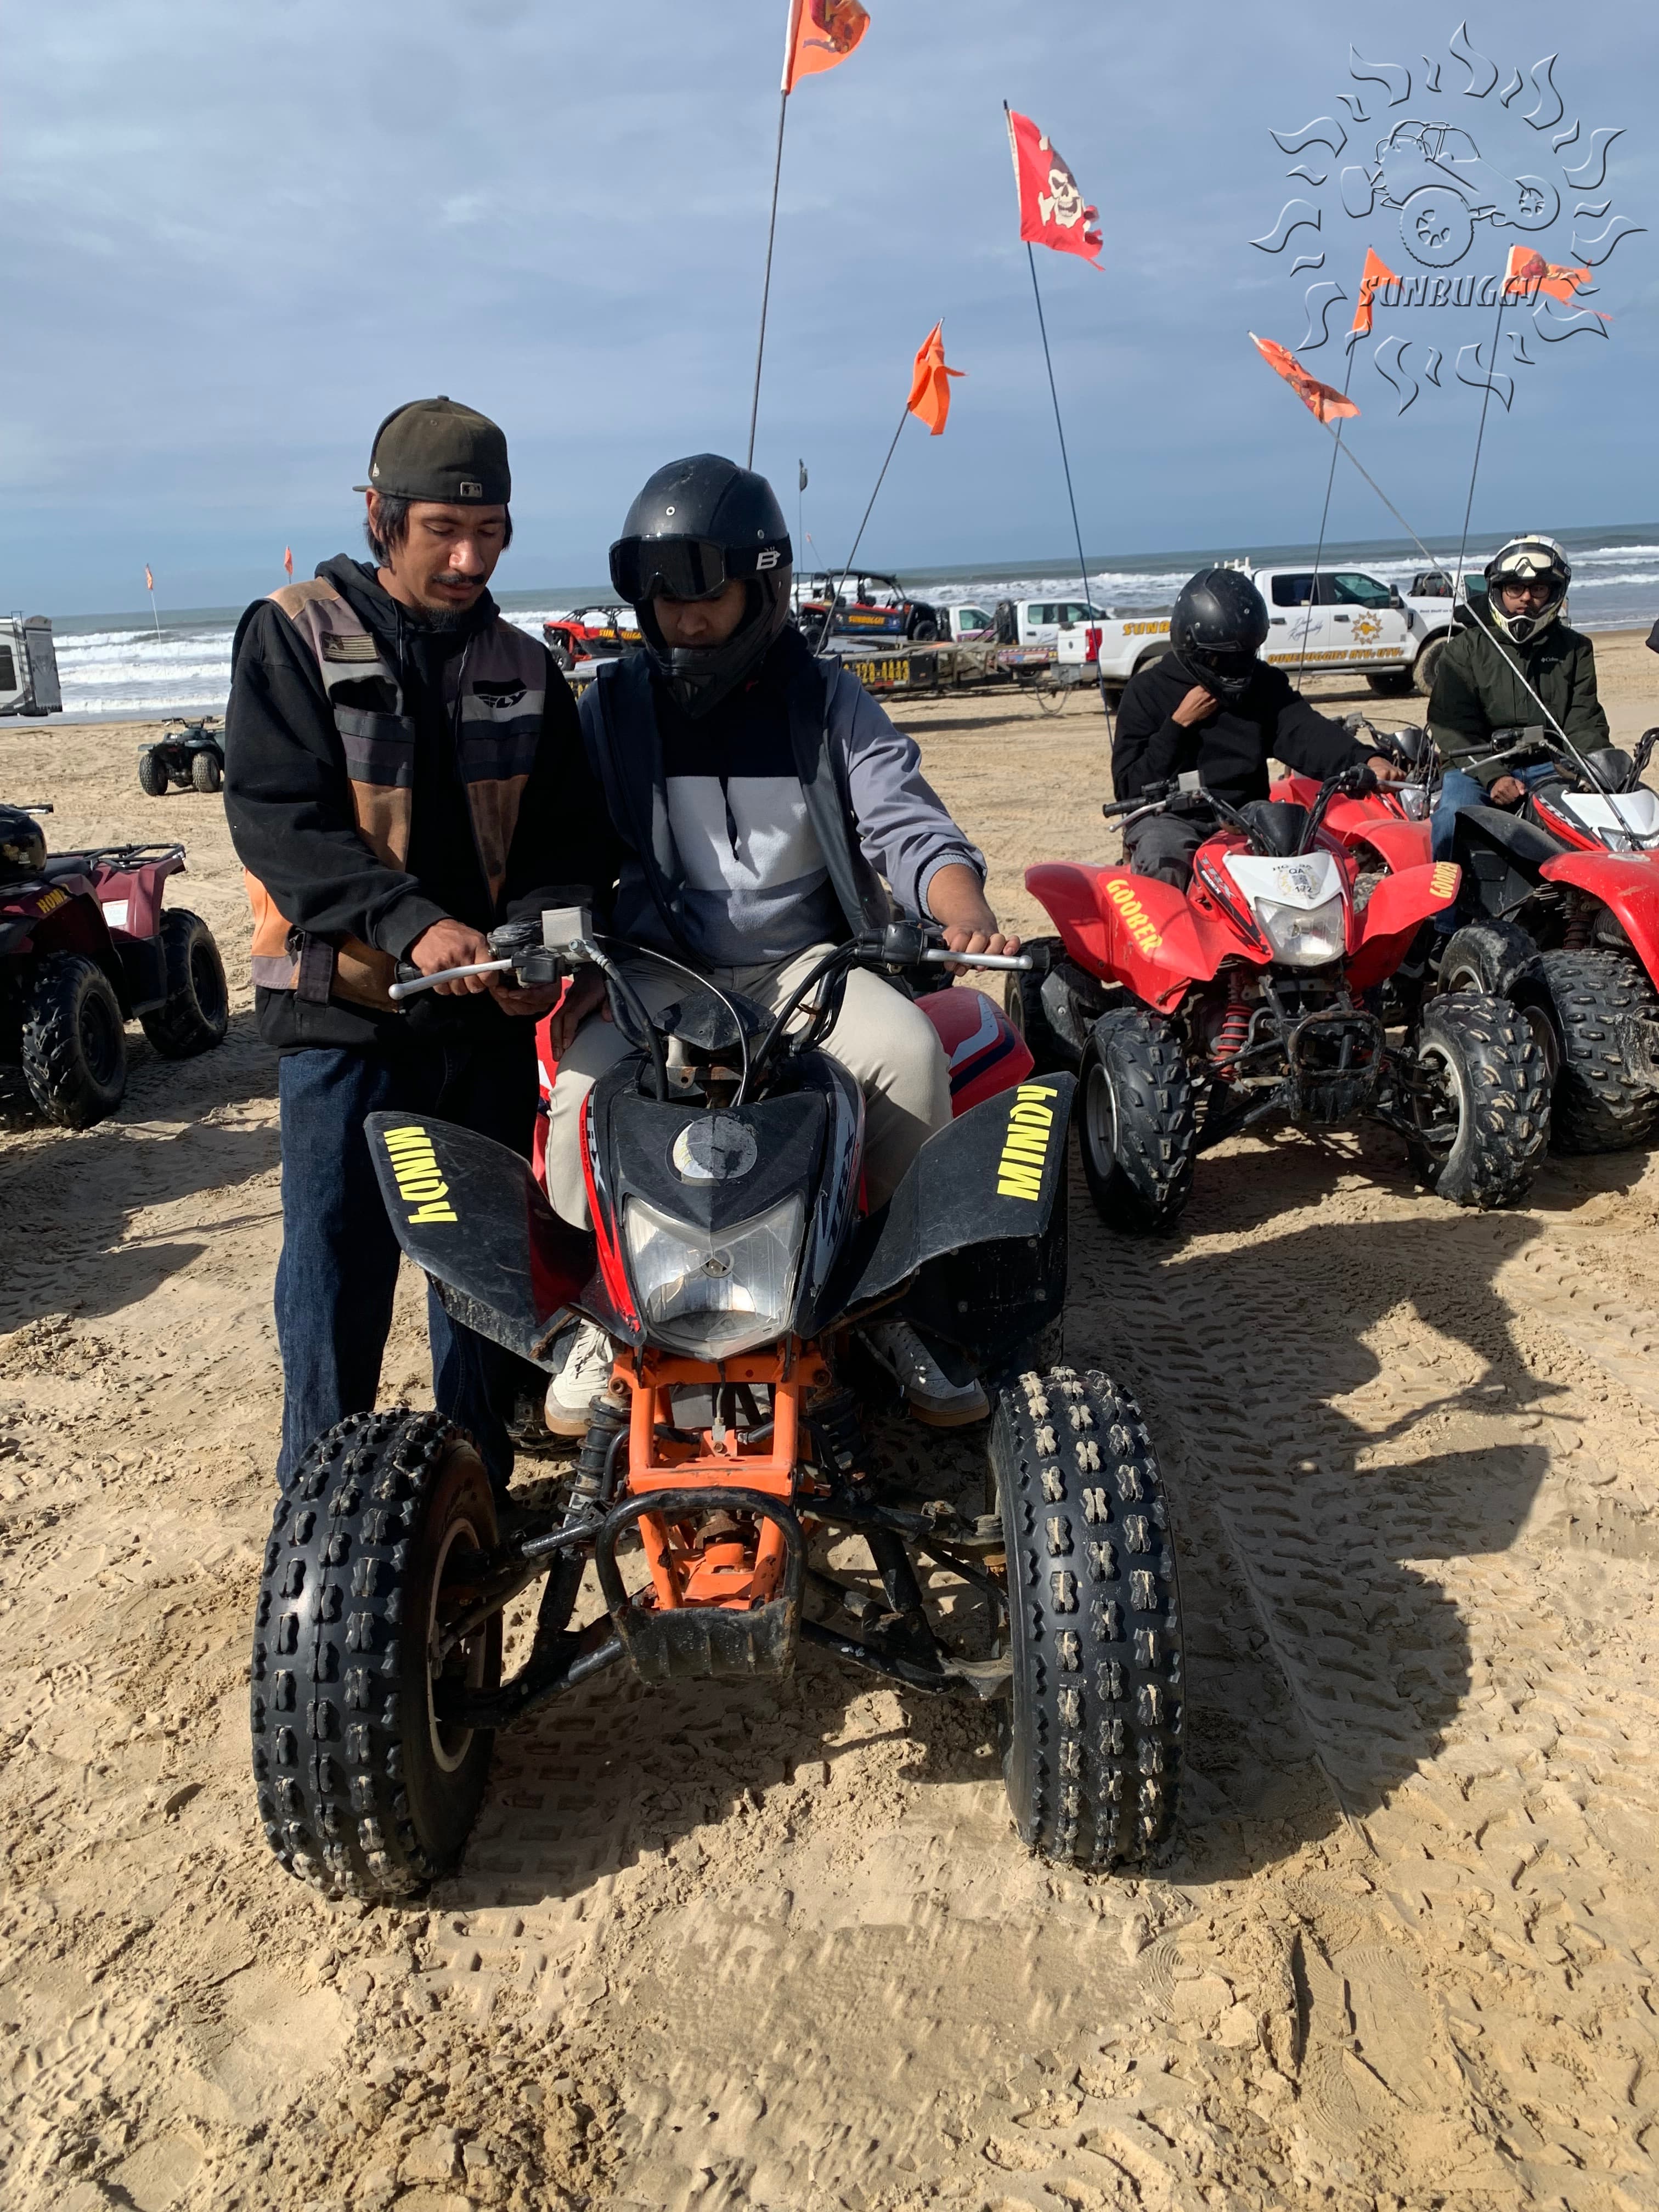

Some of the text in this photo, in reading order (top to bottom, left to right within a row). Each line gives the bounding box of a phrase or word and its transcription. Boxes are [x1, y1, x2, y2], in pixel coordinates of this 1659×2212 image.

[1106, 879, 1163, 953] GOOBER
[1429, 860, 1458, 899] GOOBER
[383, 1126, 459, 1224] MINDY
[996, 1085, 1058, 1201] MINDY
